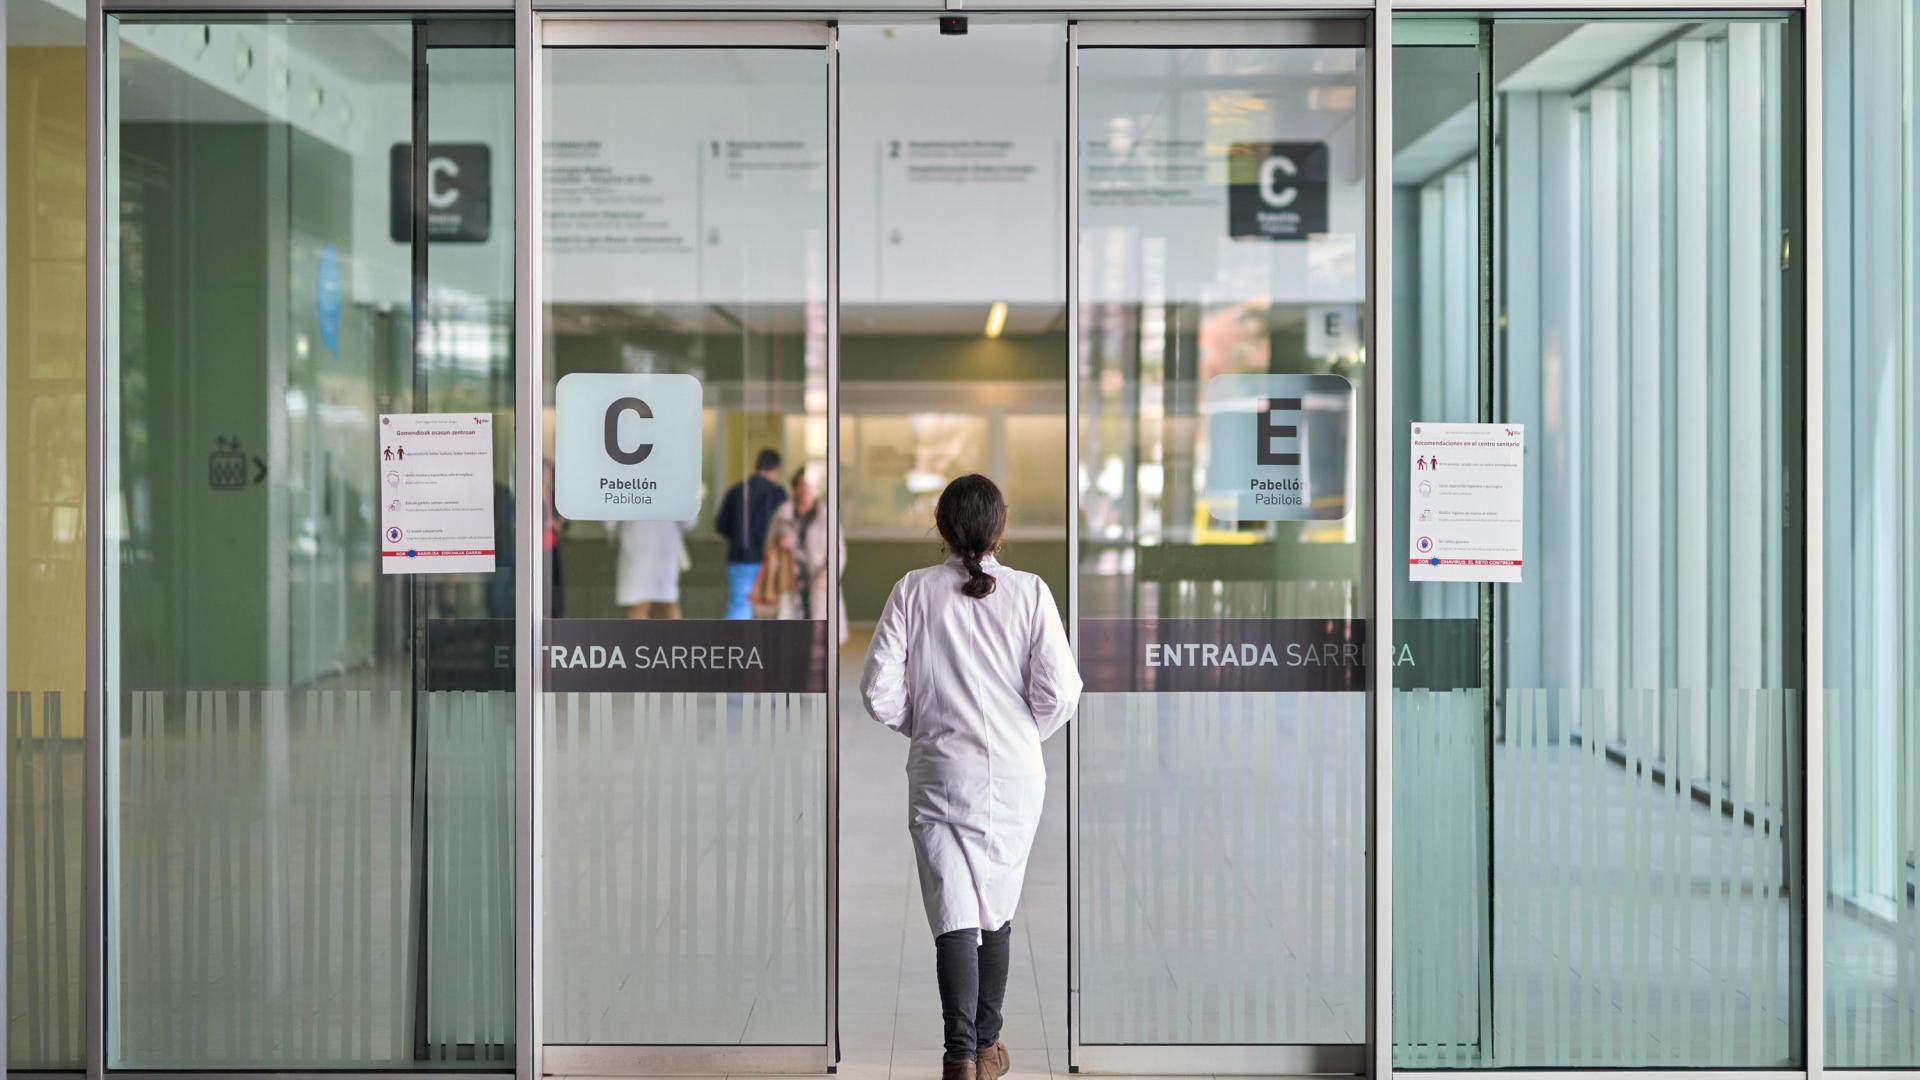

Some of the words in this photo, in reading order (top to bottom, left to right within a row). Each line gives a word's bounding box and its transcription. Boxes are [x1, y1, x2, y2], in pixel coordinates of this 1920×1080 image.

[428, 156, 459, 208] C
[1260, 155, 1298, 208] C
[1325, 313, 1341, 337] E
[604, 396, 654, 465] C
[1257, 398, 1302, 466] E
[600, 477, 657, 490] Pabellón
[604, 492, 652, 505] Pabiloia
[1255, 493, 1303, 505] Pabiloia
[635, 645, 764, 669] SARRERA
[1145, 643, 1278, 667] ENTRADA
